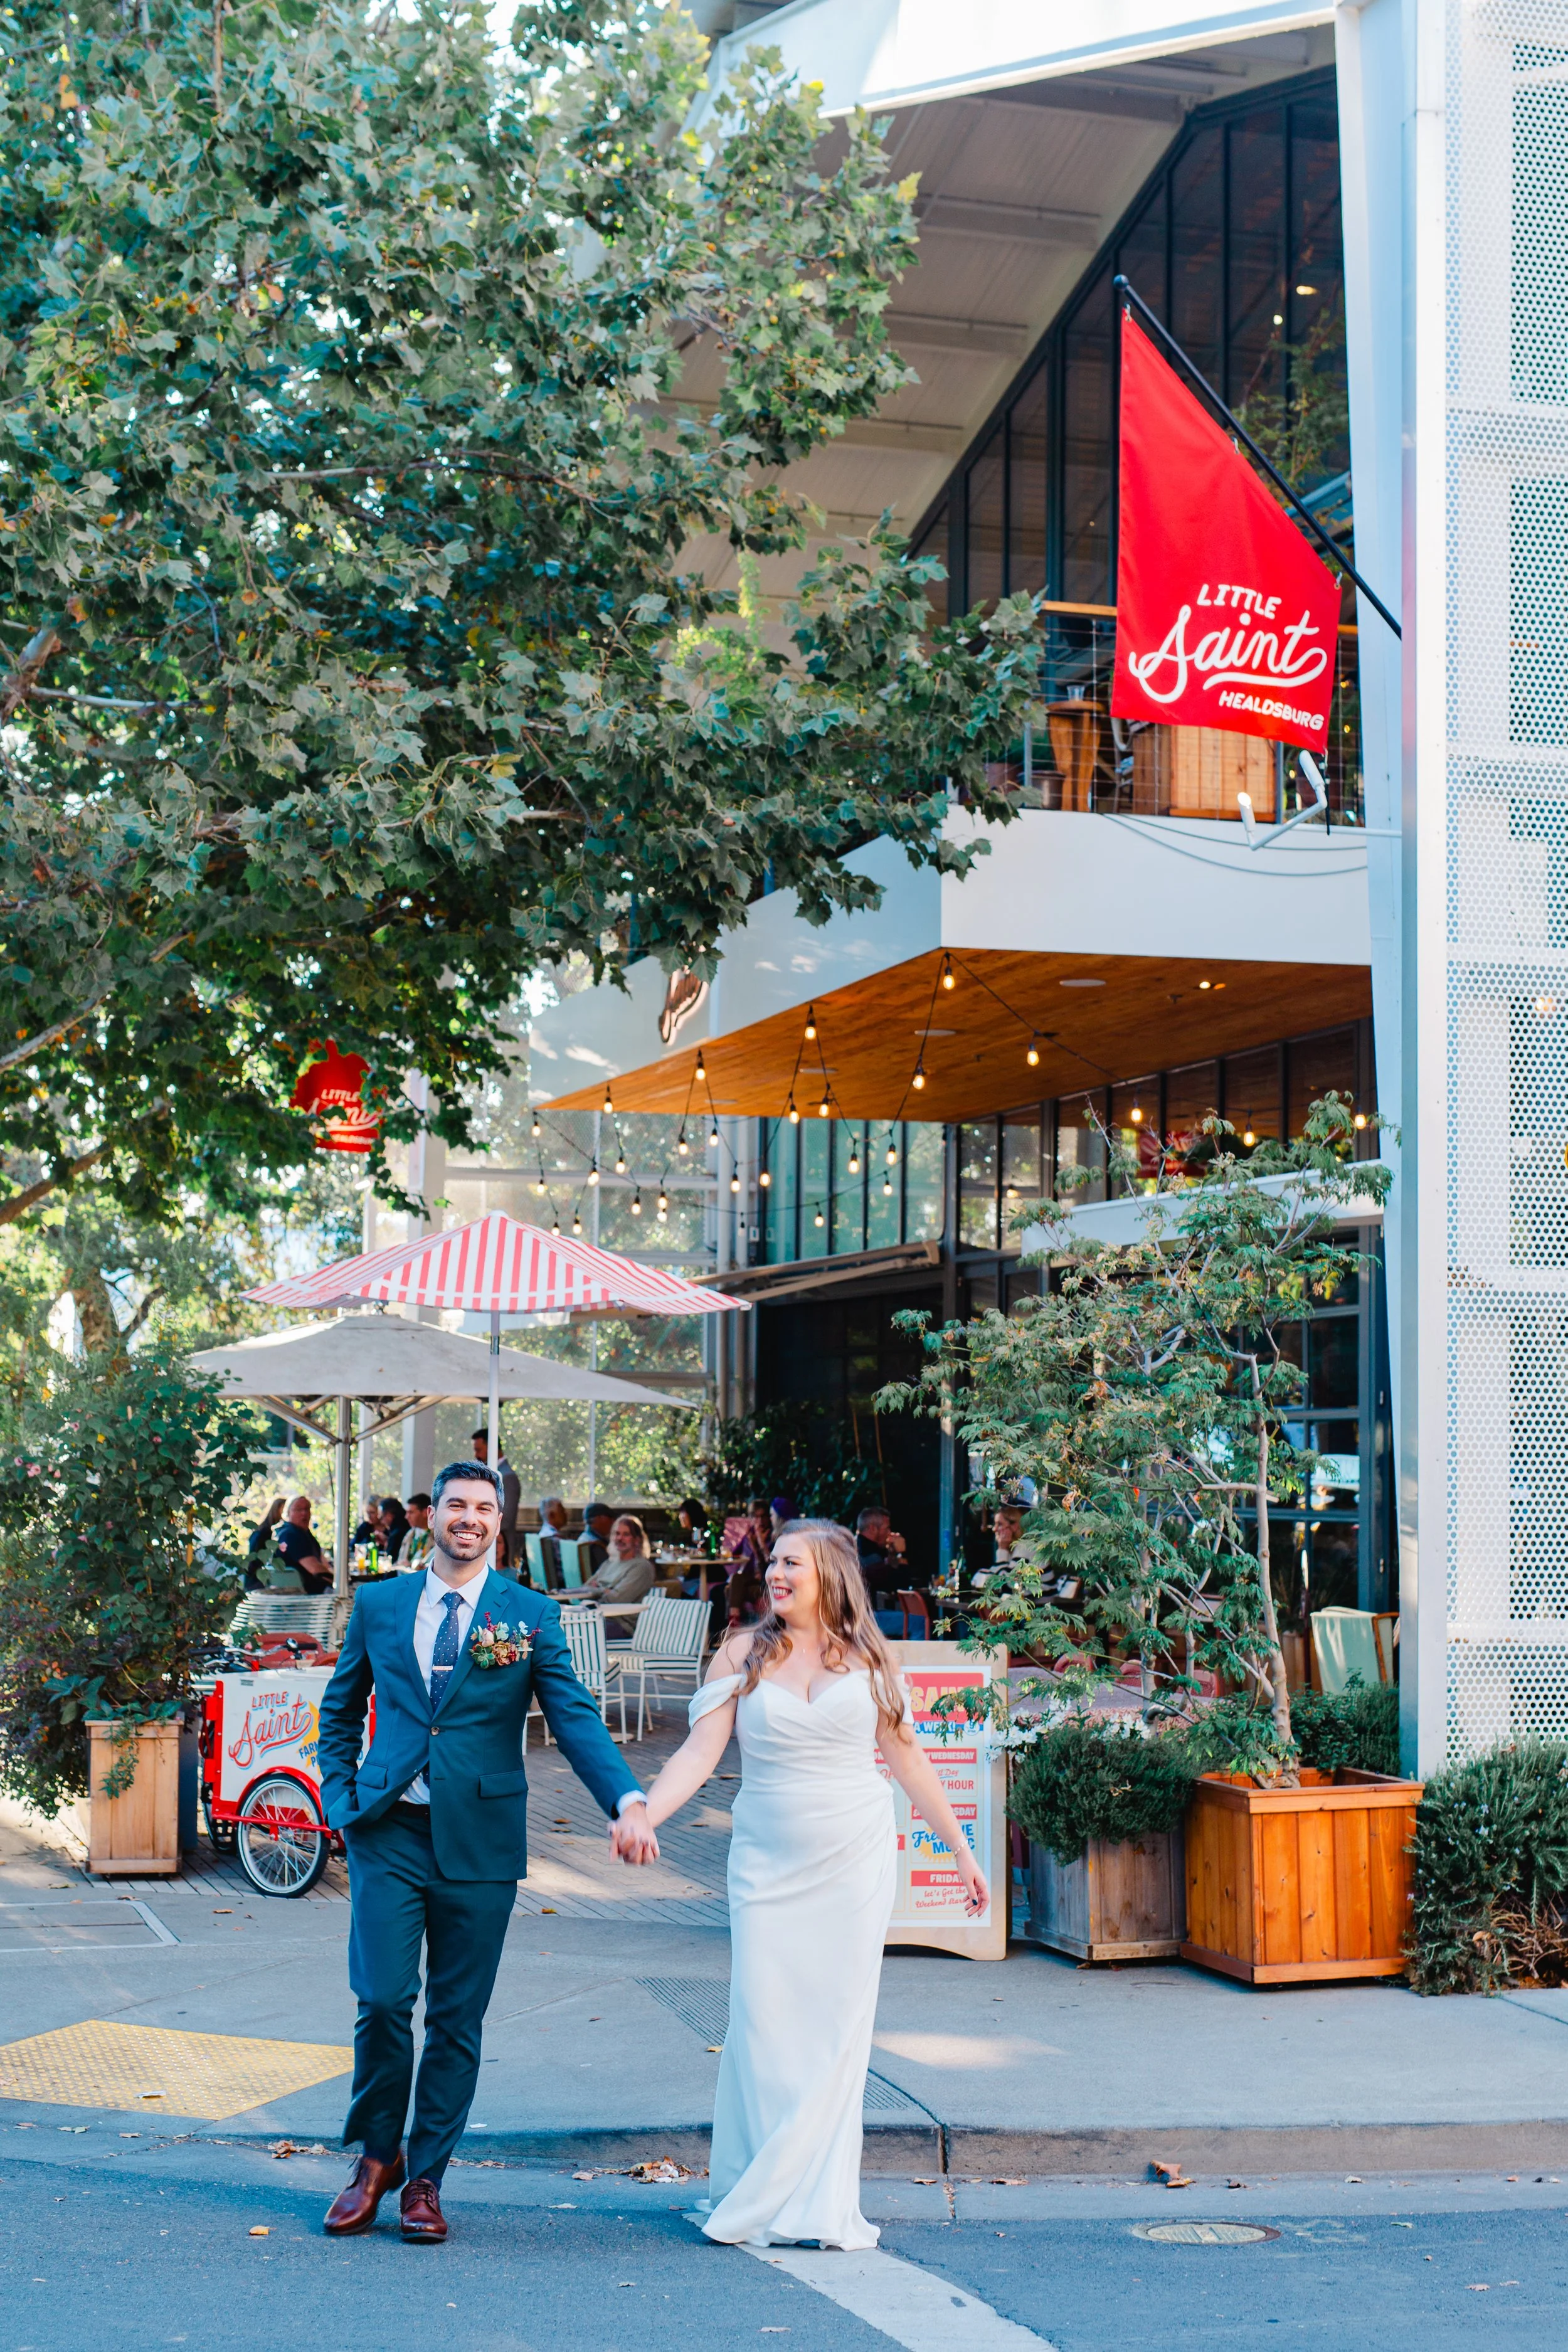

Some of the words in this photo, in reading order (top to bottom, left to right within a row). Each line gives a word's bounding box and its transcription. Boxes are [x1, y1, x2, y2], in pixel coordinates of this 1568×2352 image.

[1197, 583, 1281, 620] LITTLE
[1128, 604, 1327, 704] Saint
[1218, 690, 1325, 731] HEALDSBURG
[252, 1690, 290, 1709] LITTLE
[228, 1693, 314, 1770] Saint
[923, 1721, 956, 1734] WEK!
[931, 1751, 975, 1760] WEDNESDAY
[948, 1780, 974, 1790] HOUR
[912, 1830, 940, 1848] Fre
[930, 1873, 963, 1883] FRIDA
